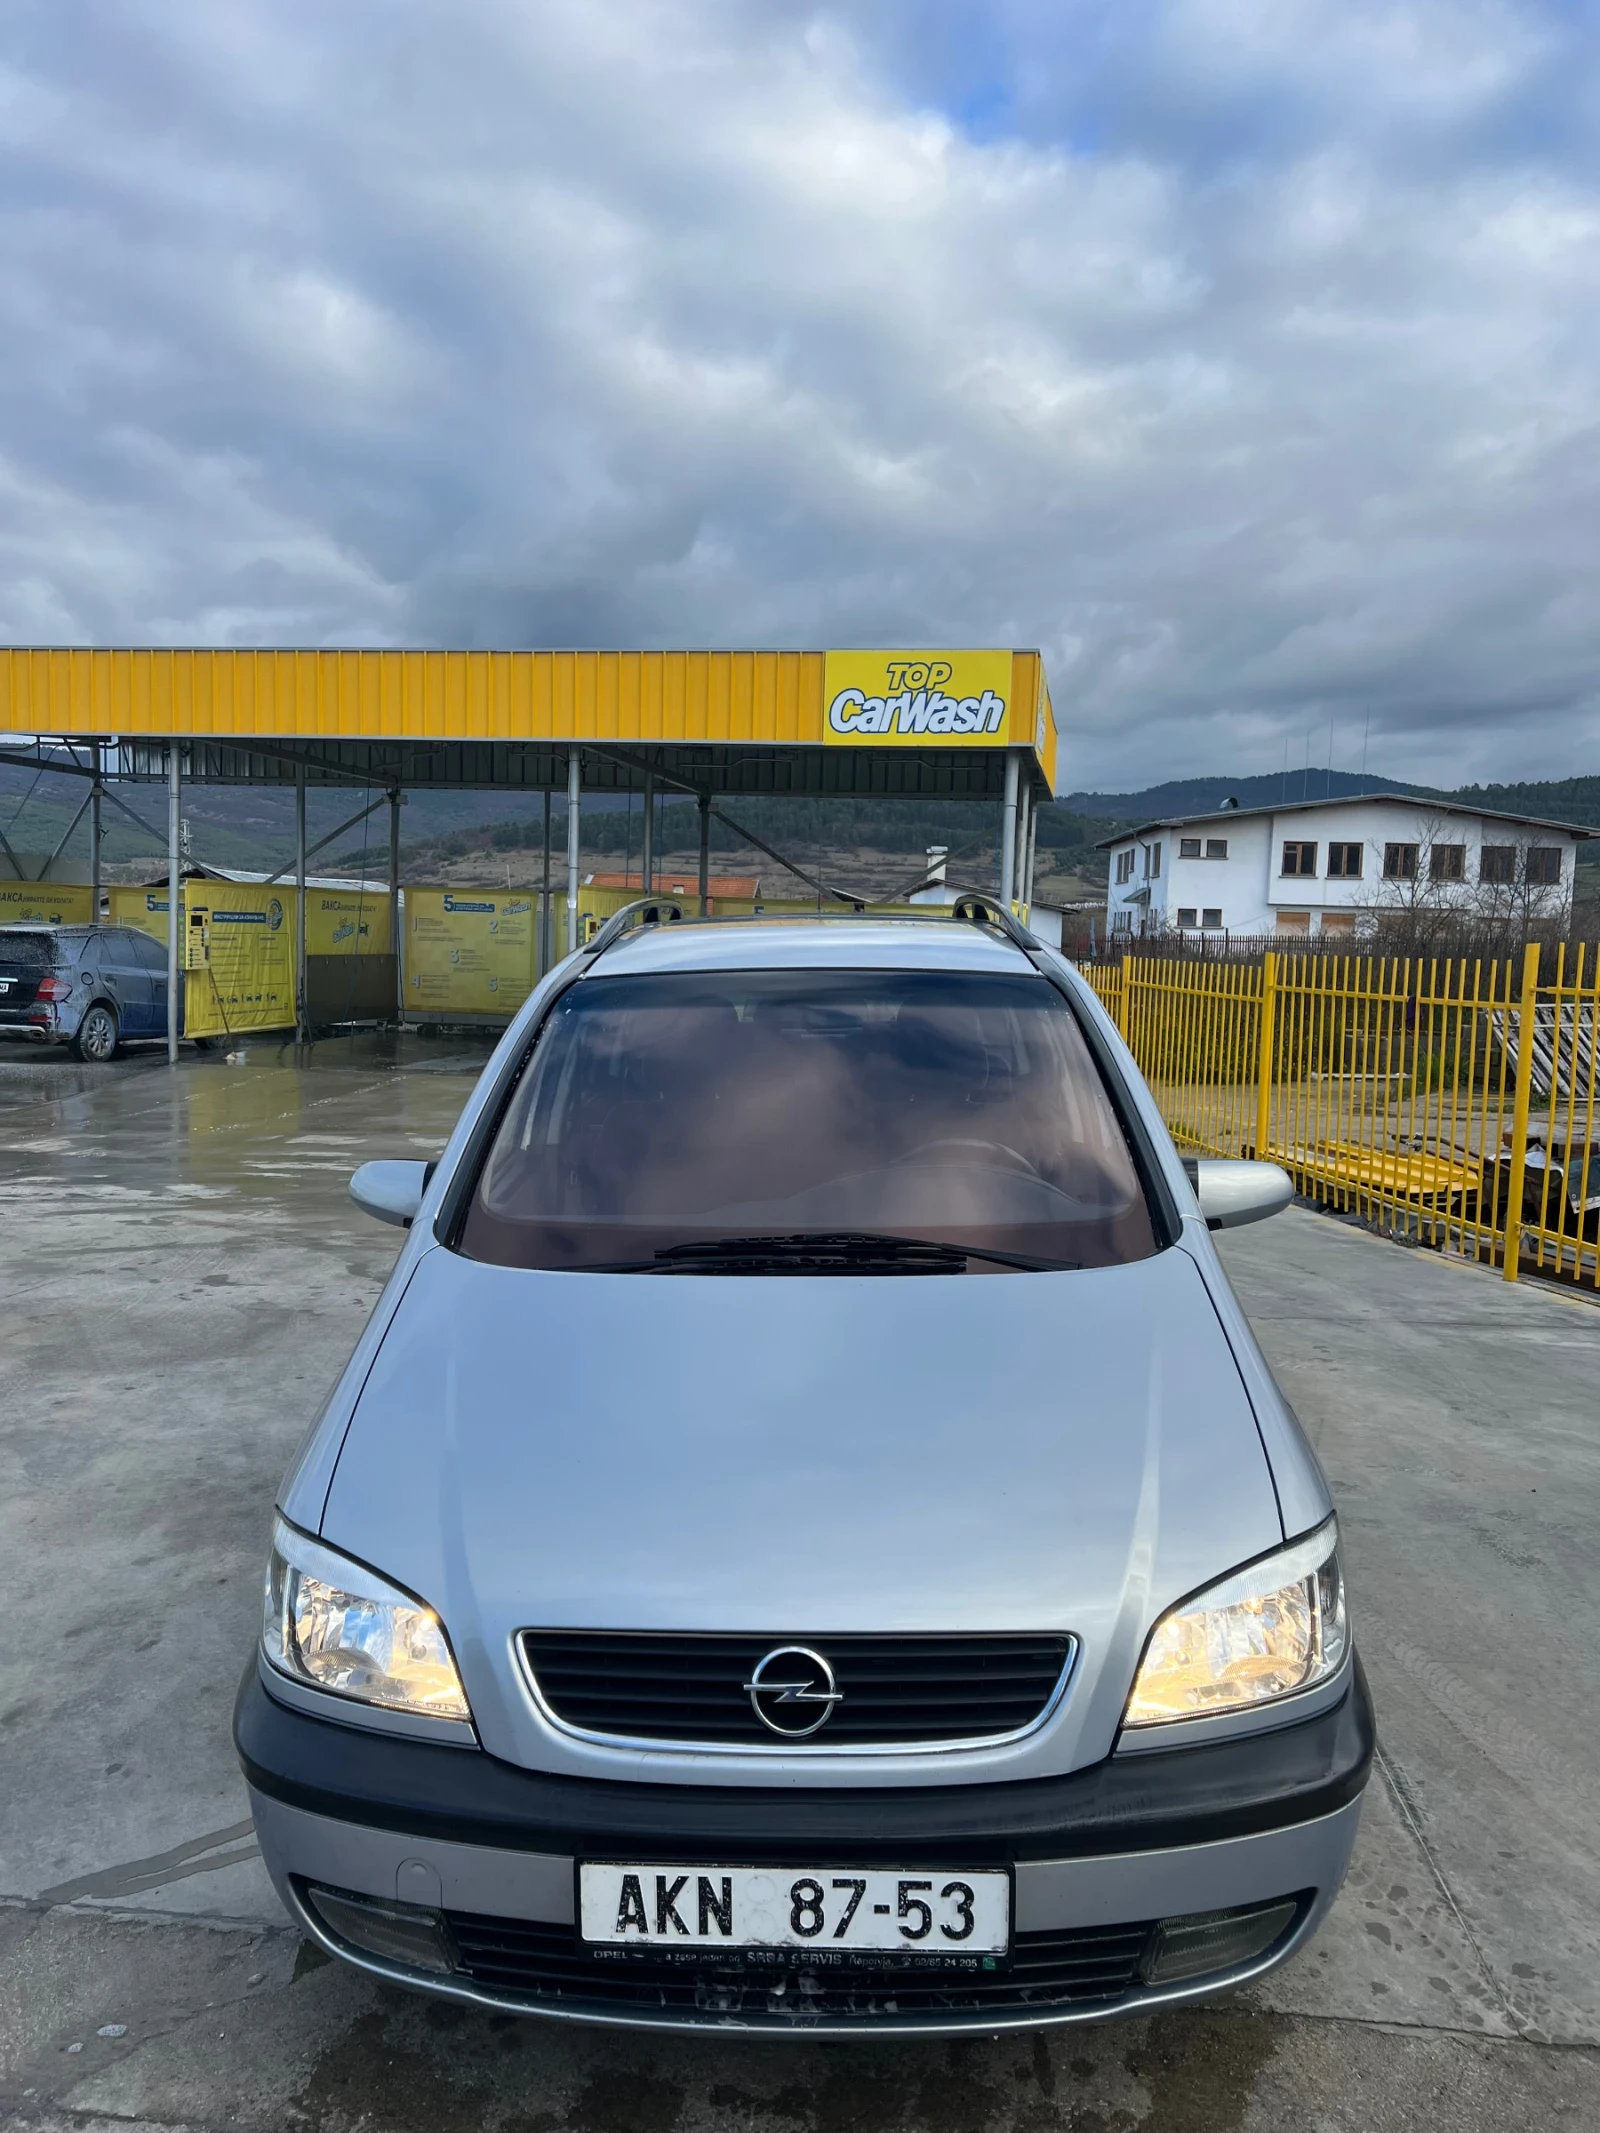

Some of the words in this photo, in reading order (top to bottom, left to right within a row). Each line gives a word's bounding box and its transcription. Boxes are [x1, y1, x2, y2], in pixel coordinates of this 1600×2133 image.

[887, 662, 952, 690] TOP
[829, 688, 1005, 733] CarWash
[0, 893, 23, 903] АКСА
[146, 894, 156, 912] 5
[443, 894, 454, 912] 5
[501, 902, 532, 916] CarWash
[489, 919, 499, 935] 2
[450, 948, 460, 964] 3
[411, 974, 421, 989] 4
[488, 977, 498, 992] 5
[615, 1873, 733, 1937] AKN
[789, 1877, 976, 1941] 87-53
[593, 1950, 629, 1959] OPEL
[790, 1952, 842, 1965] SERVIS
[944, 1958, 957, 1967] 24
[959, 1958, 978, 1968] 205
